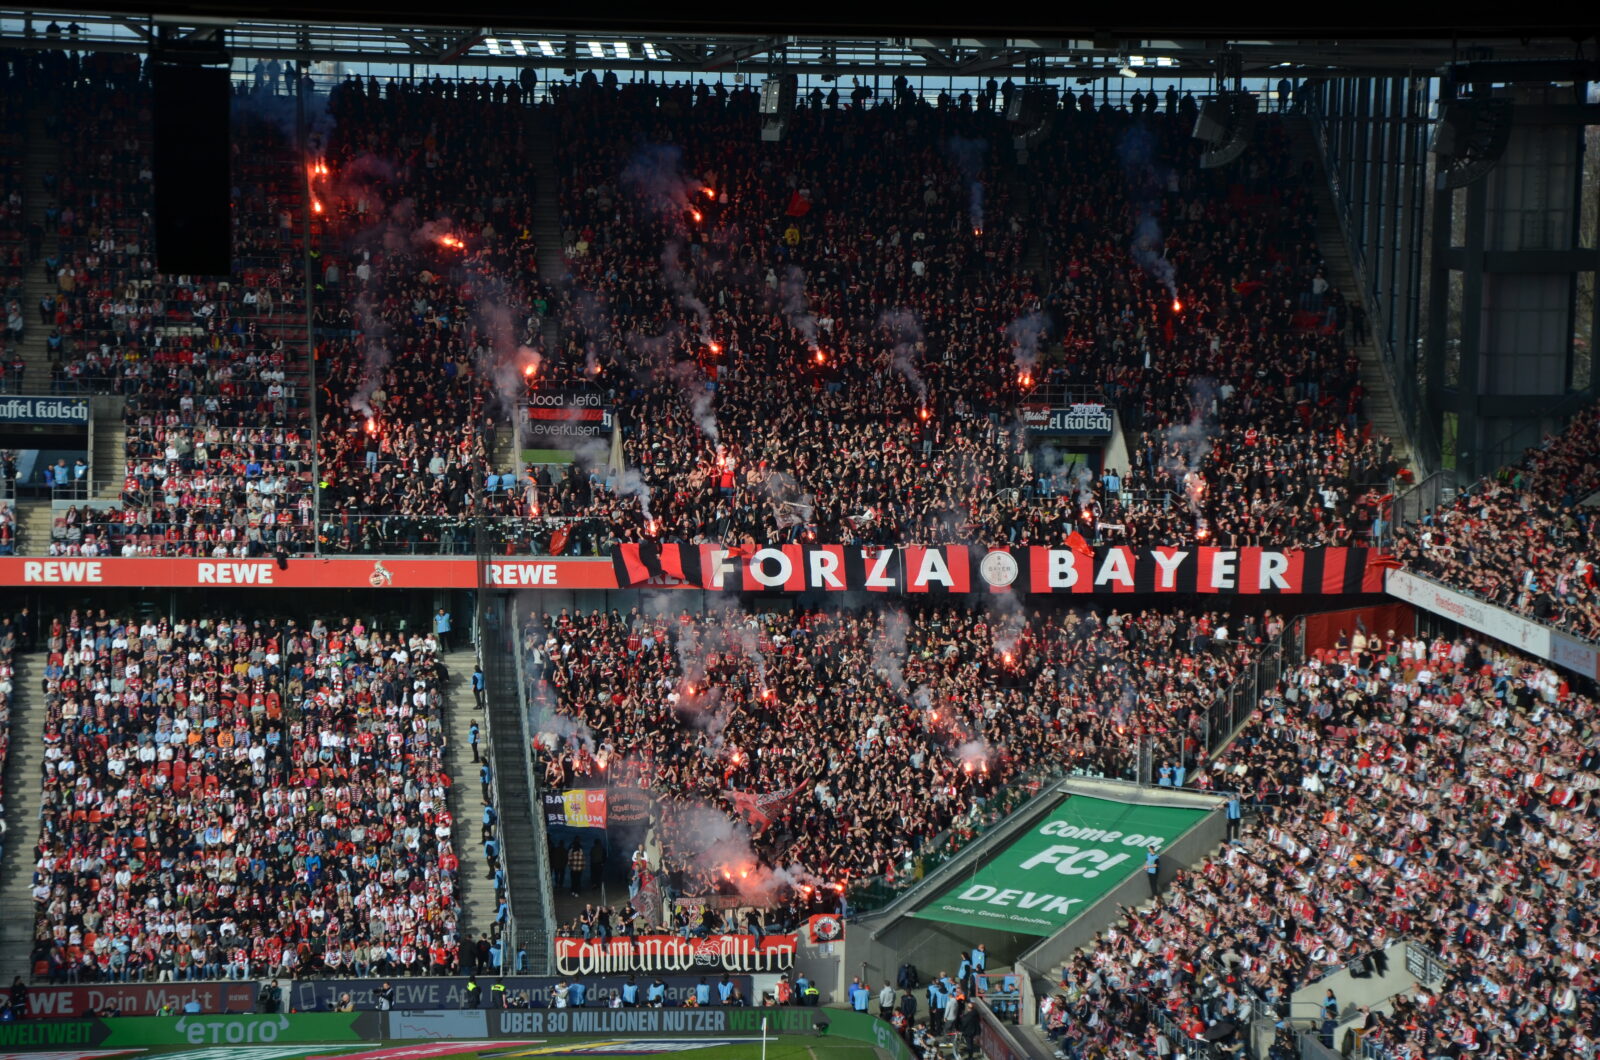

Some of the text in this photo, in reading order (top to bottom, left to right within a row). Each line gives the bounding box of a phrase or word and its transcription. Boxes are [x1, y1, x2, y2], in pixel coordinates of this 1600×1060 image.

[529, 393, 564, 406] Jood
[529, 421, 600, 436] Leverkusen
[24, 561, 103, 582] REWE
[197, 563, 273, 584] REWE
[485, 564, 558, 585] REWE
[710, 548, 1292, 589] FORZA BAYER
[545, 793, 583, 804] BAYER
[588, 793, 605, 803] 04
[548, 813, 604, 823] BELGIUM
[1039, 820, 1123, 843] Come
[1019, 844, 1131, 879] FC!
[957, 884, 1083, 915] DEVK
[556, 936, 794, 976] Commando Ultra
[500, 1010, 815, 1033] ÜBER 30 MILLIONEN NUTZER WELTWEIT
[0, 1022, 93, 1046] WELTWEIT
